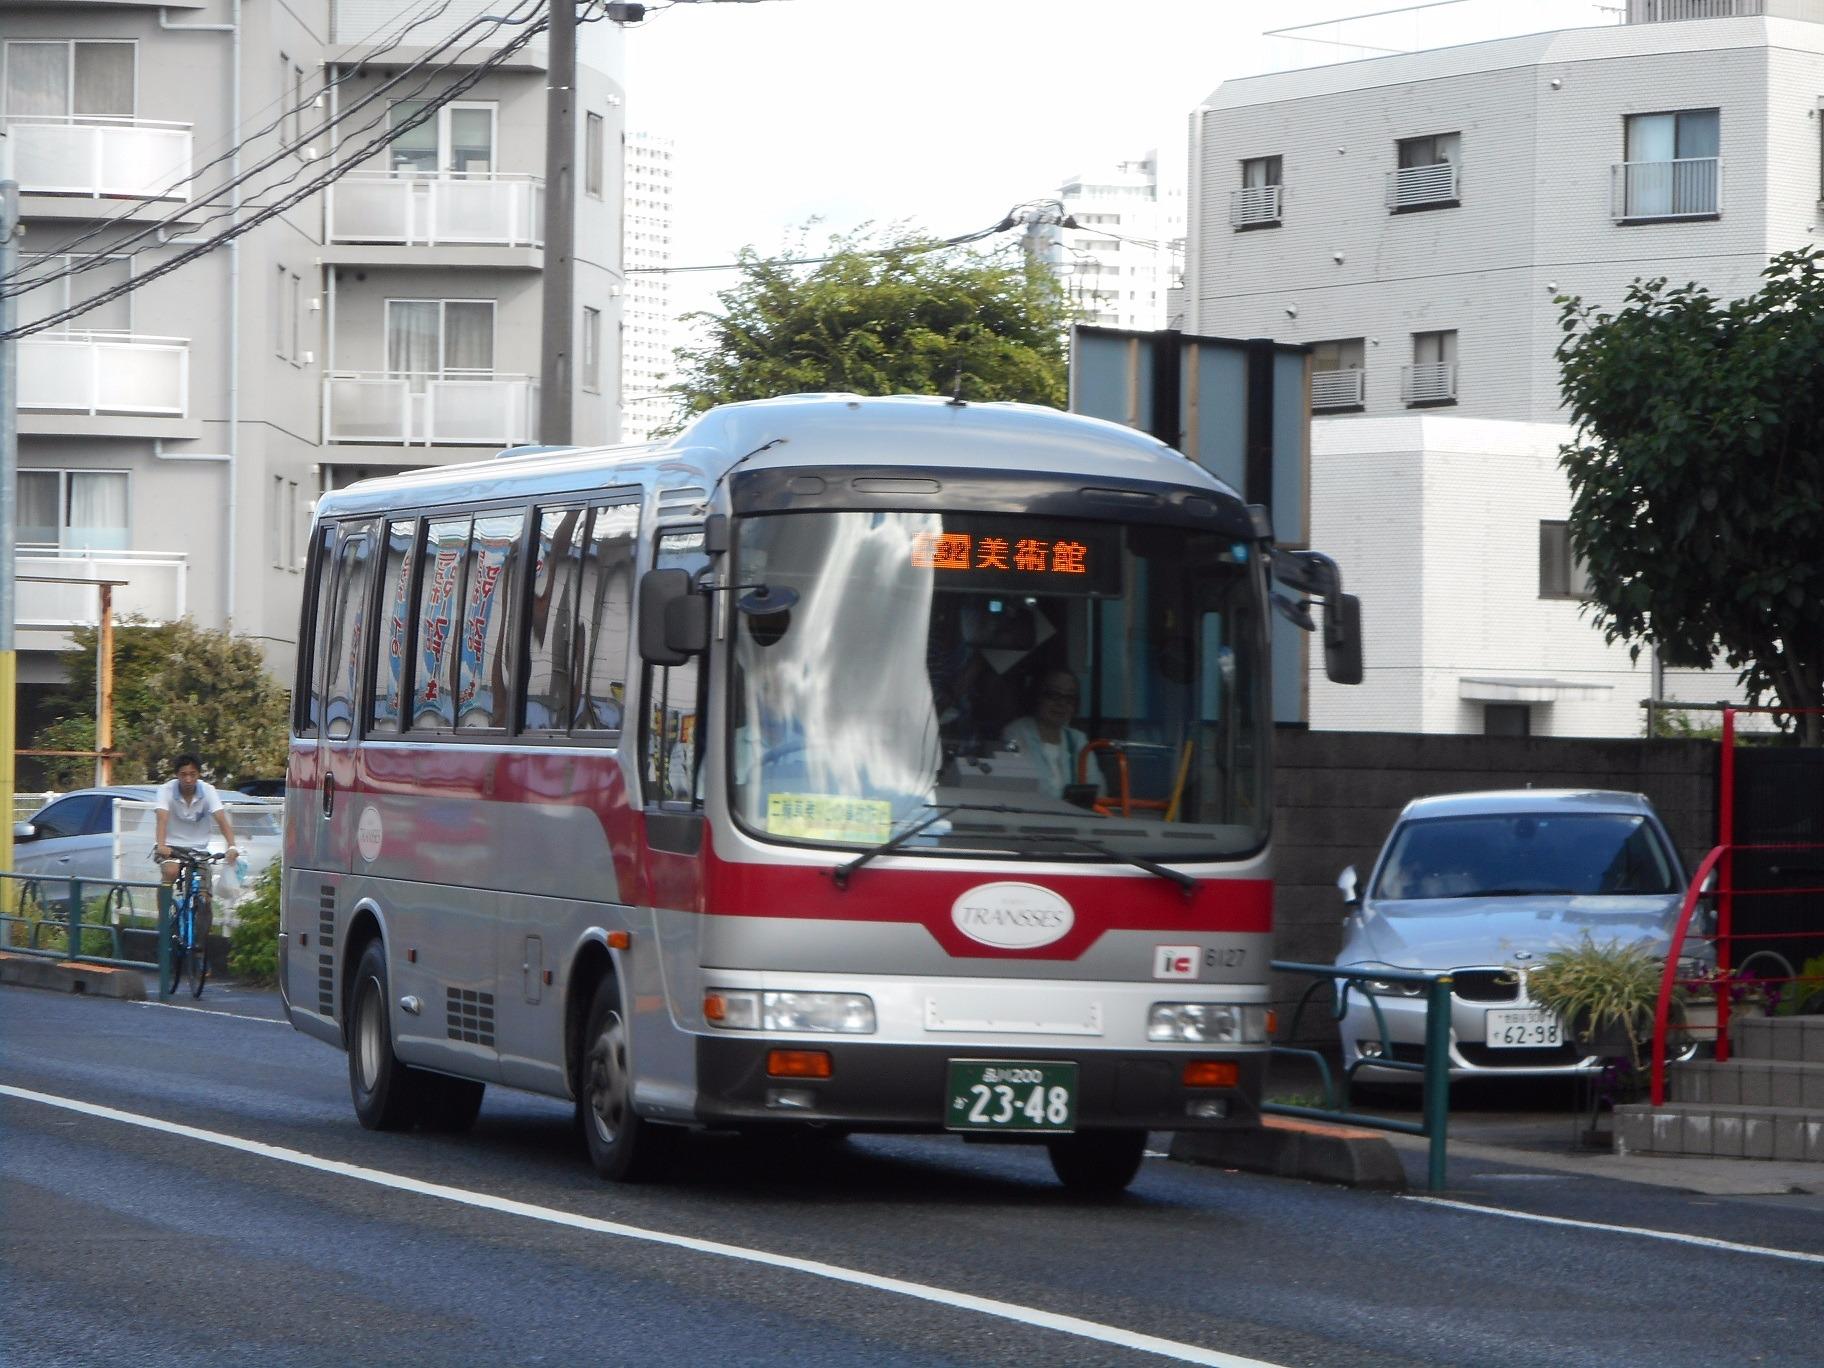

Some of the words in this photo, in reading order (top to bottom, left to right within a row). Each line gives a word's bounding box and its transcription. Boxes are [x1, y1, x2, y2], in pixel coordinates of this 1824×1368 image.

[976, 537, 1087, 573] 美術館
[960, 906, 1064, 928] TRANSSES
[968, 1084, 1069, 1124] 23-48
